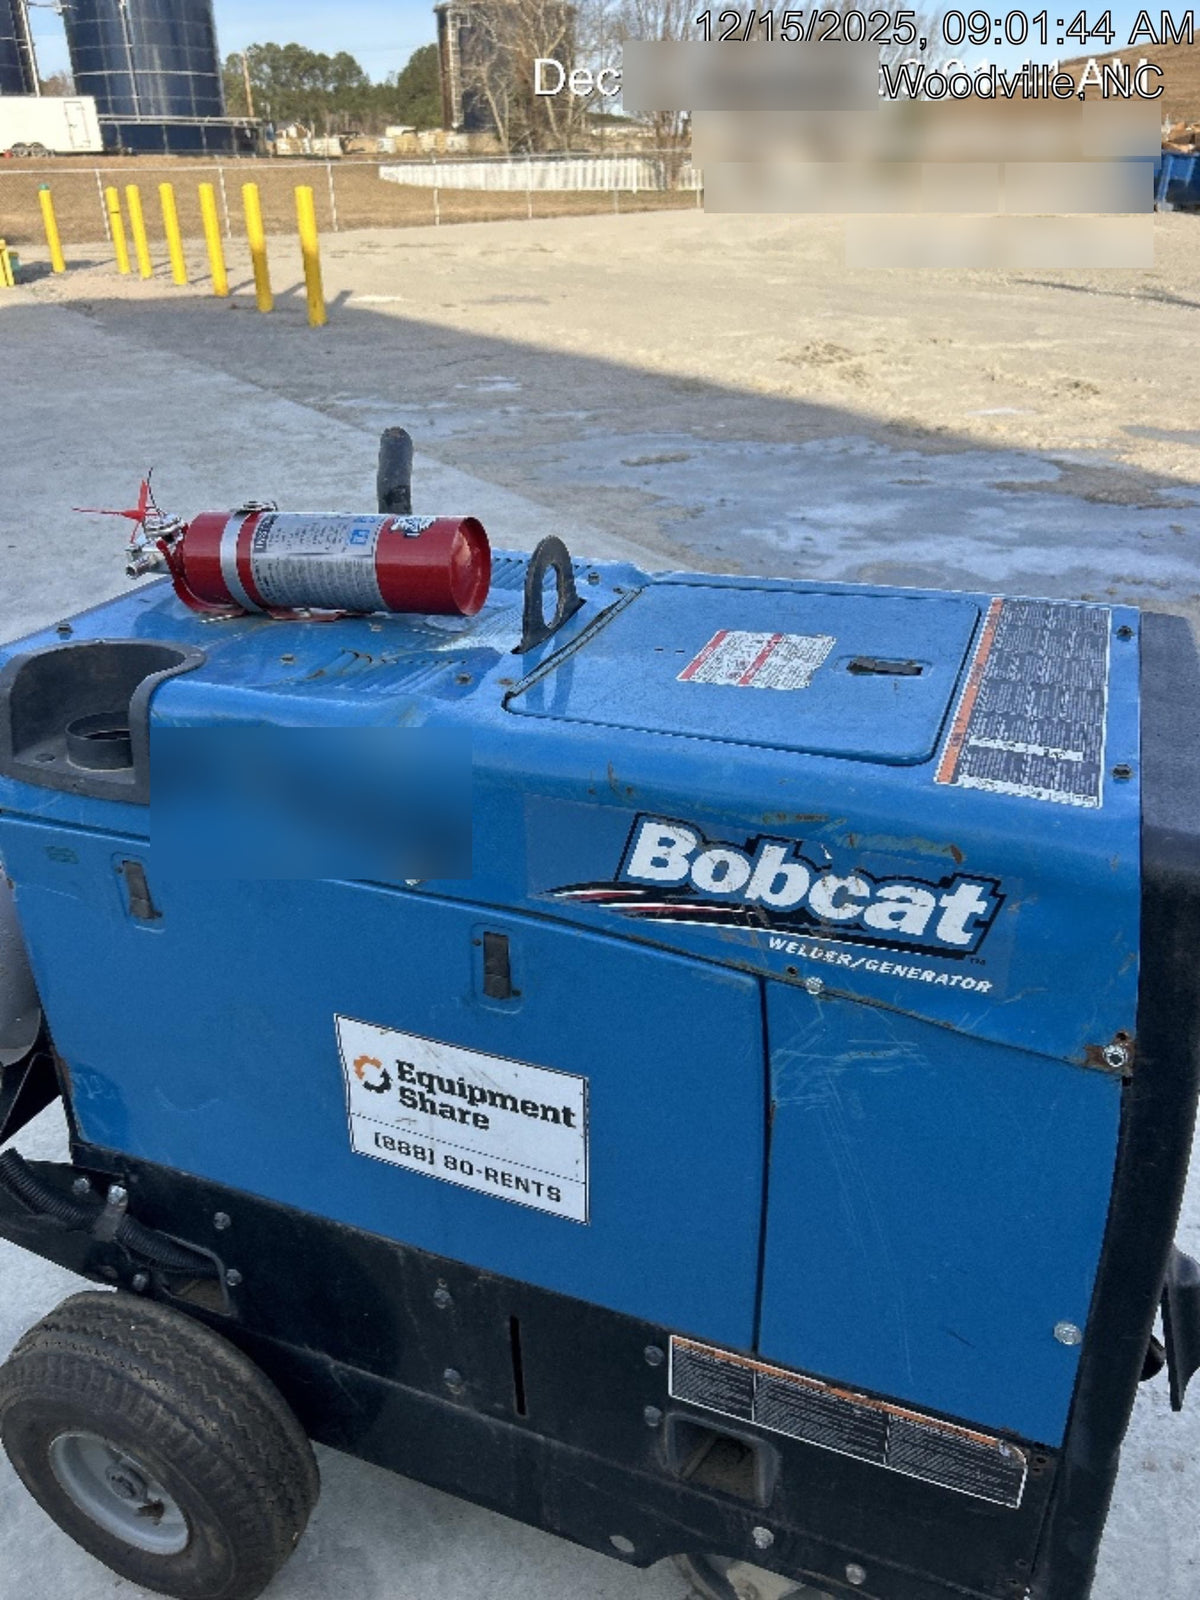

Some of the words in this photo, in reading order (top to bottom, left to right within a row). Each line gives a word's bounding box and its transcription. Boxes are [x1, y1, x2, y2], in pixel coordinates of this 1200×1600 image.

[626, 822, 987, 945] Bobcat
[769, 936, 992, 992] WELDER/GENERATOR
[395, 1059, 577, 1129] Equipment
[399, 1085, 490, 1130] Share
[444, 1154, 561, 1203] 80-RENTS
